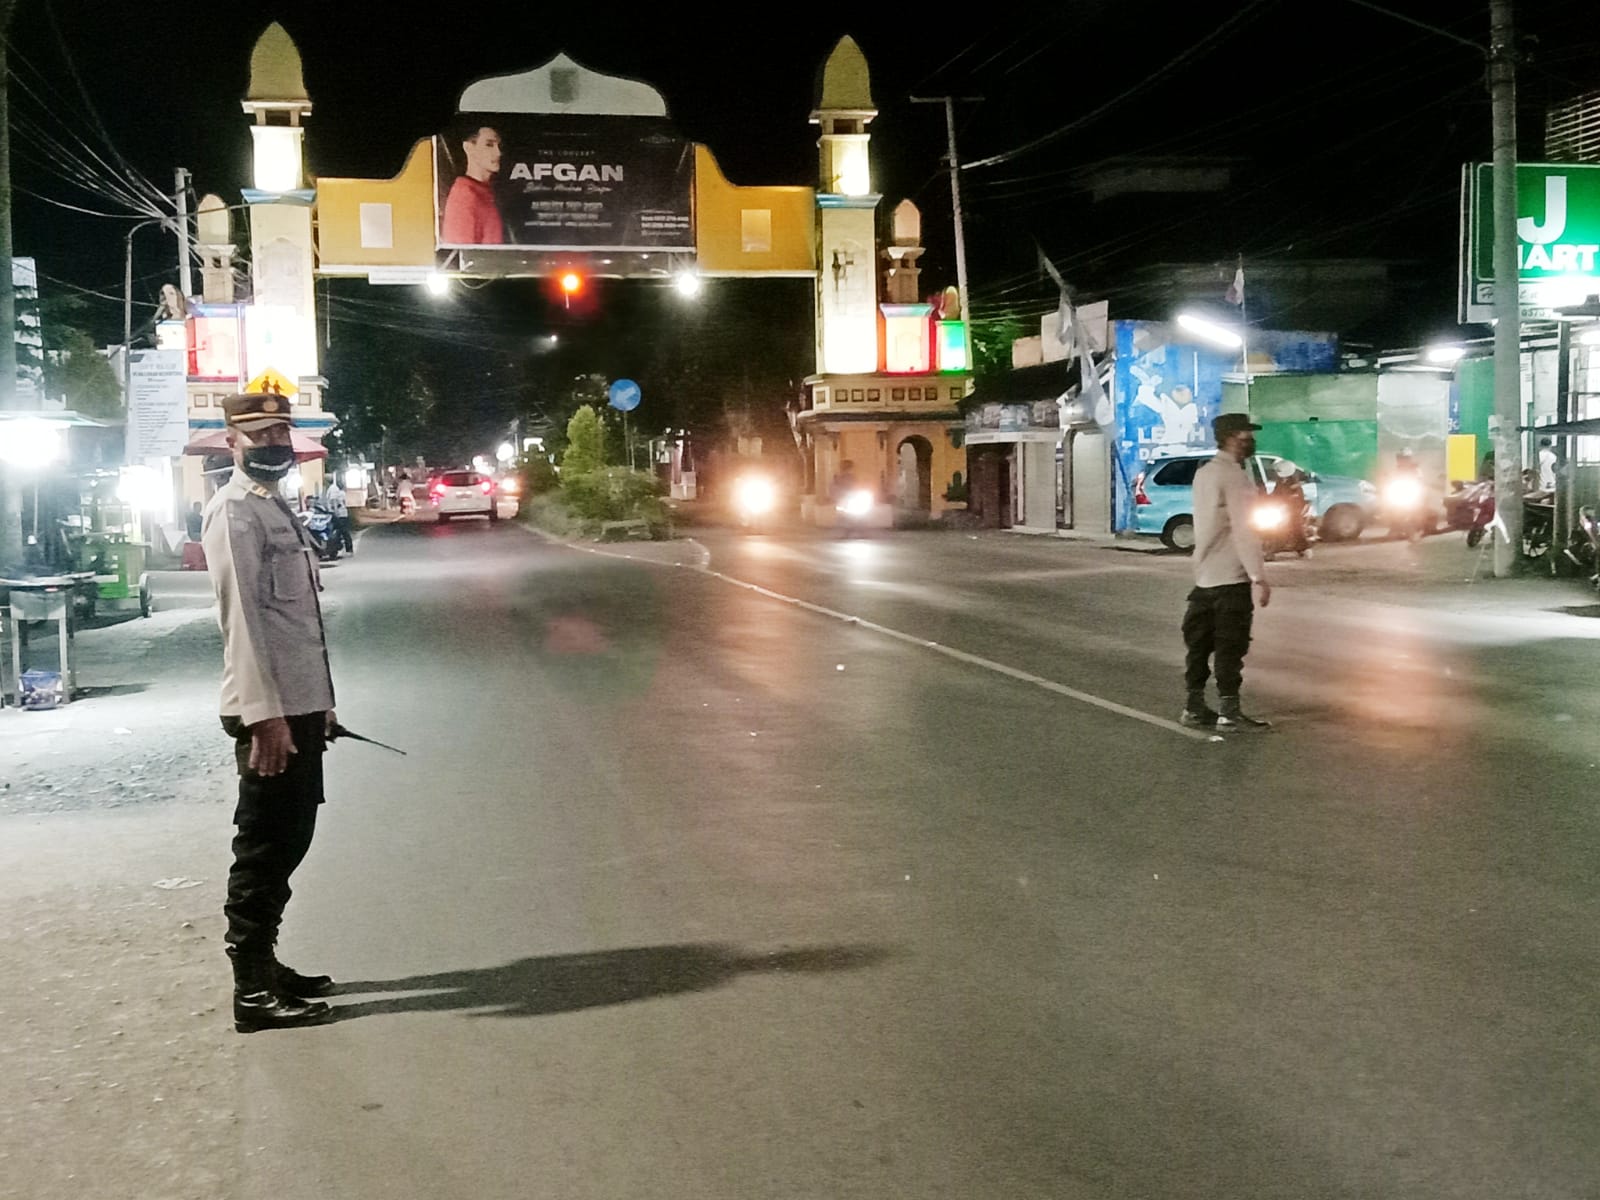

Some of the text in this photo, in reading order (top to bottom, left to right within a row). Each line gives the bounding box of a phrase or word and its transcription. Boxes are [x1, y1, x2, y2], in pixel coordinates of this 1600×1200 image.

[509, 163, 624, 182] AFGAN
[1517, 176, 1567, 244] J
[1517, 244, 1599, 271] ART
